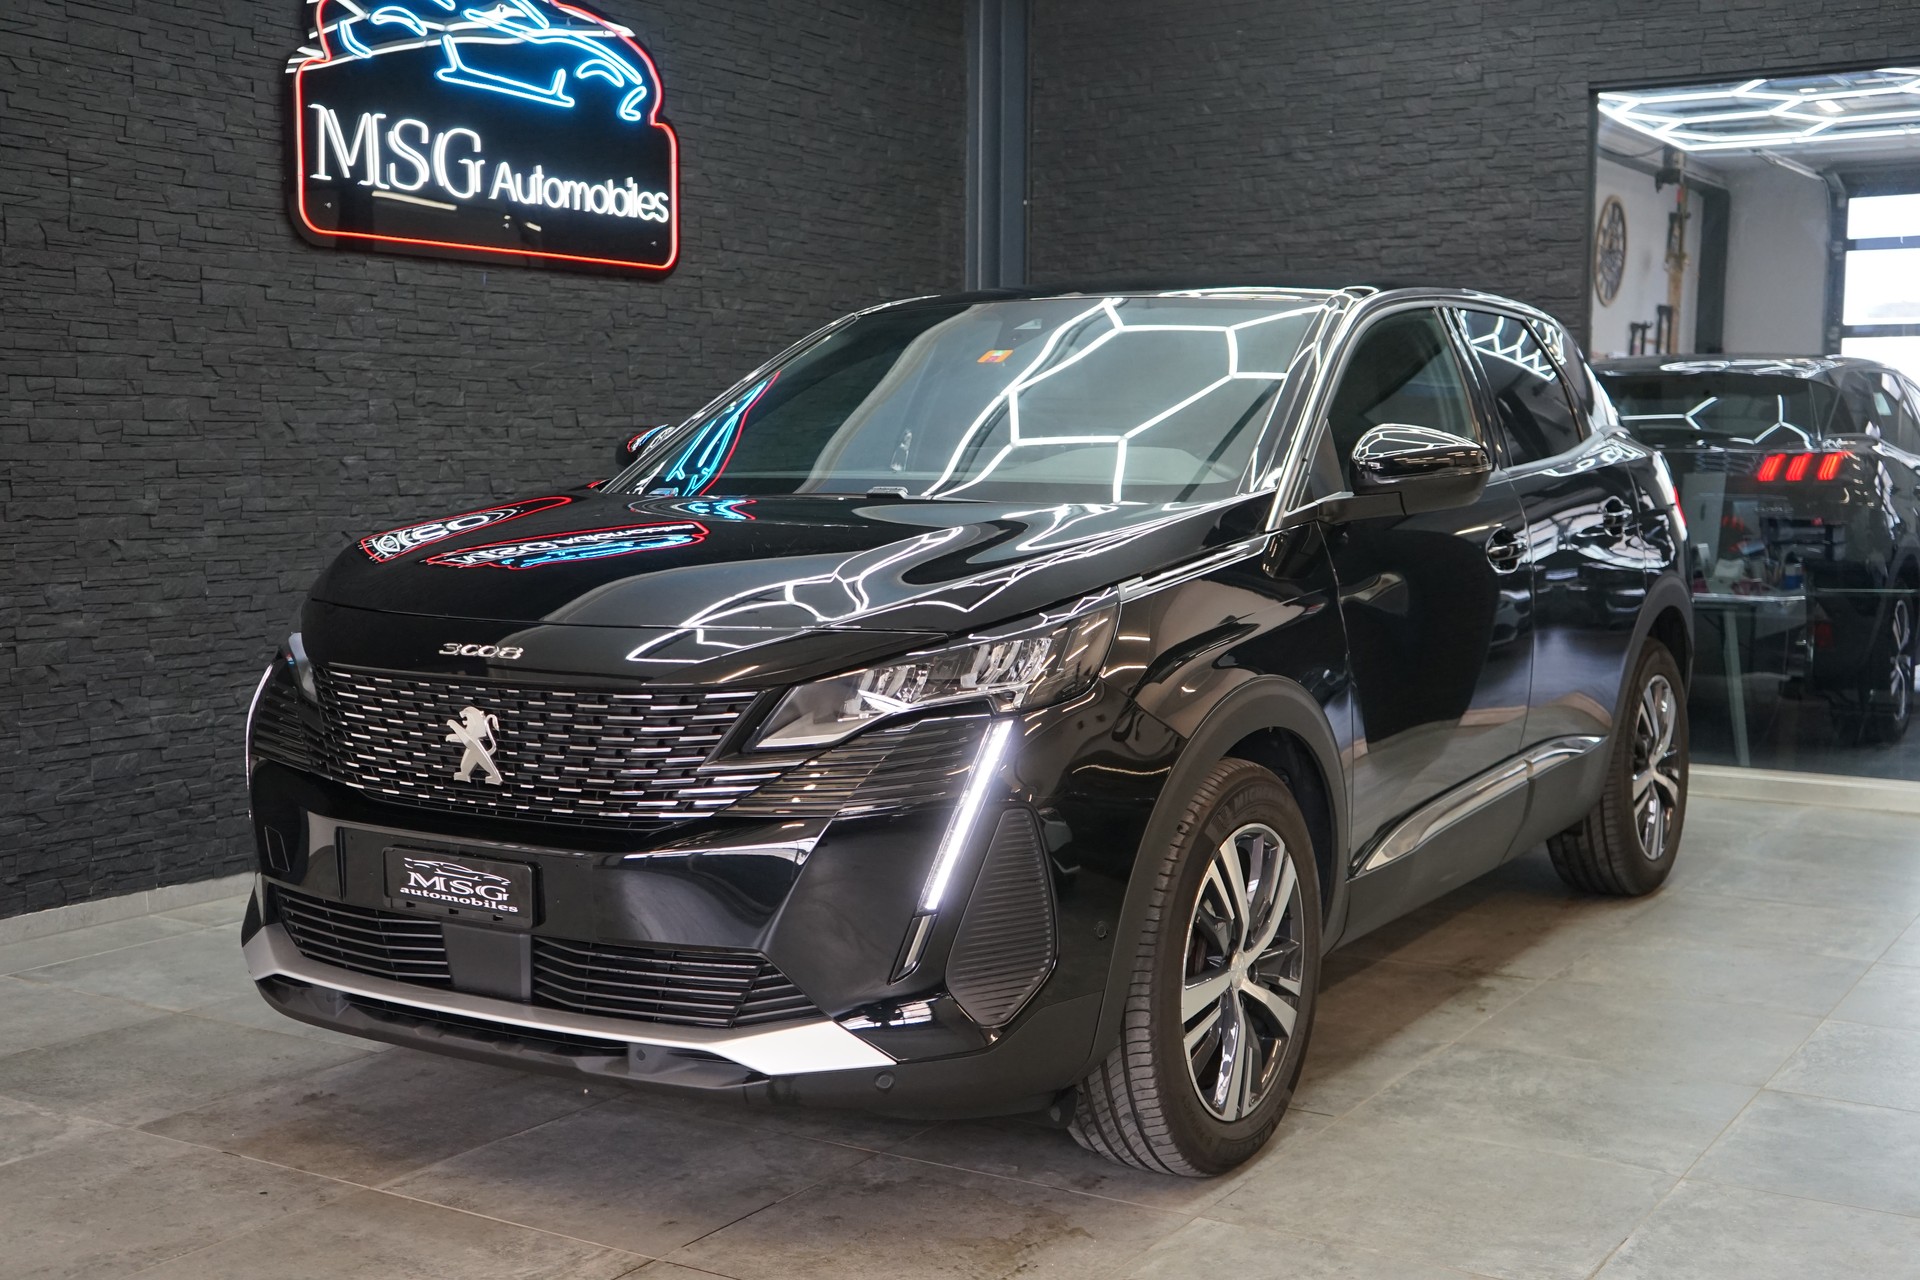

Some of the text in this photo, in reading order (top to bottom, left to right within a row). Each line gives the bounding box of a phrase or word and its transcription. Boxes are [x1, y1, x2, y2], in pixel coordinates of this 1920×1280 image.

[307, 103, 670, 223] MSG Automobiles
[438, 642, 524, 660] 3008
[400, 886, 519, 913] automobiles
[407, 871, 510, 901] MSG
